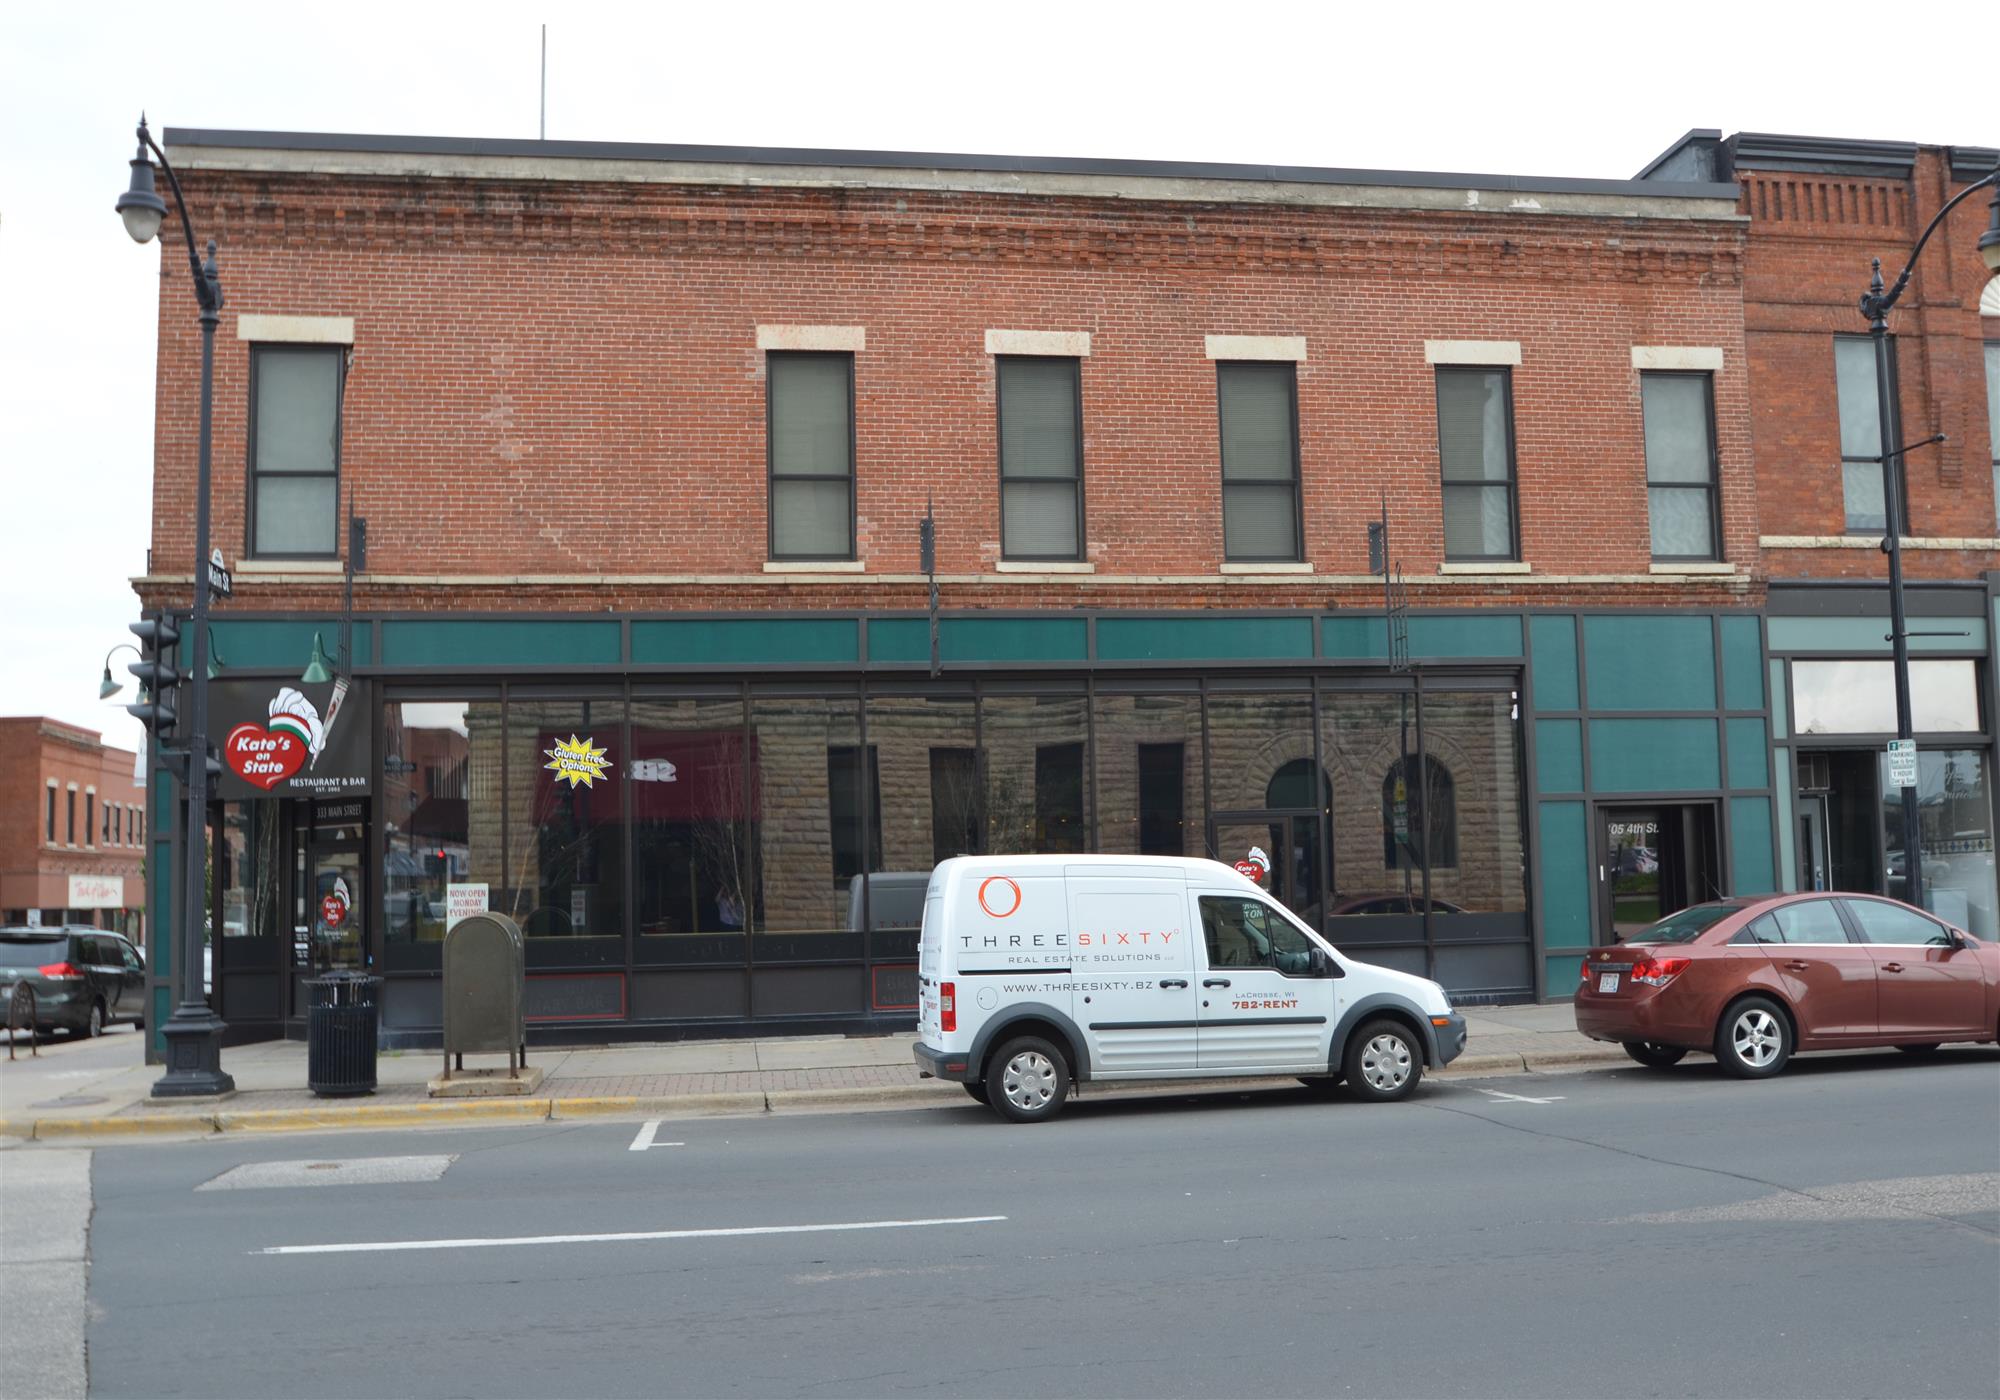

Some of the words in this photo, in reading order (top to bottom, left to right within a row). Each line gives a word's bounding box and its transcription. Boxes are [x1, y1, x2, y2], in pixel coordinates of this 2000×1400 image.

[222, 571, 230, 592] St
[237, 736, 291, 751] Kate's
[256, 752, 270, 761] on
[553, 747, 583, 761] Gluten
[585, 751, 606, 764] Free
[243, 760, 284, 774] State
[560, 760, 594, 774] Options
[289, 777, 340, 787] RESTAURANT
[341, 777, 348, 786] &
[349, 776, 366, 786] BAR
[328, 806, 342, 817] MAIN
[343, 803, 362, 816] STREET
[1626, 823, 1643, 834] 4th
[1646, 822, 1659, 834] St.
[450, 889, 466, 897] NOW
[468, 889, 486, 897] OPEN
[453, 899, 481, 907] MONDAY
[1008, 956, 1039, 964] REAL
[1044, 955, 1088, 963] ESTATE
[1093, 954, 1161, 962] SOLUTIONS
[1003, 981, 1153, 993] WWW.THREESIXTY.BZ
[1232, 1000, 1298, 1010] 782-RENT
